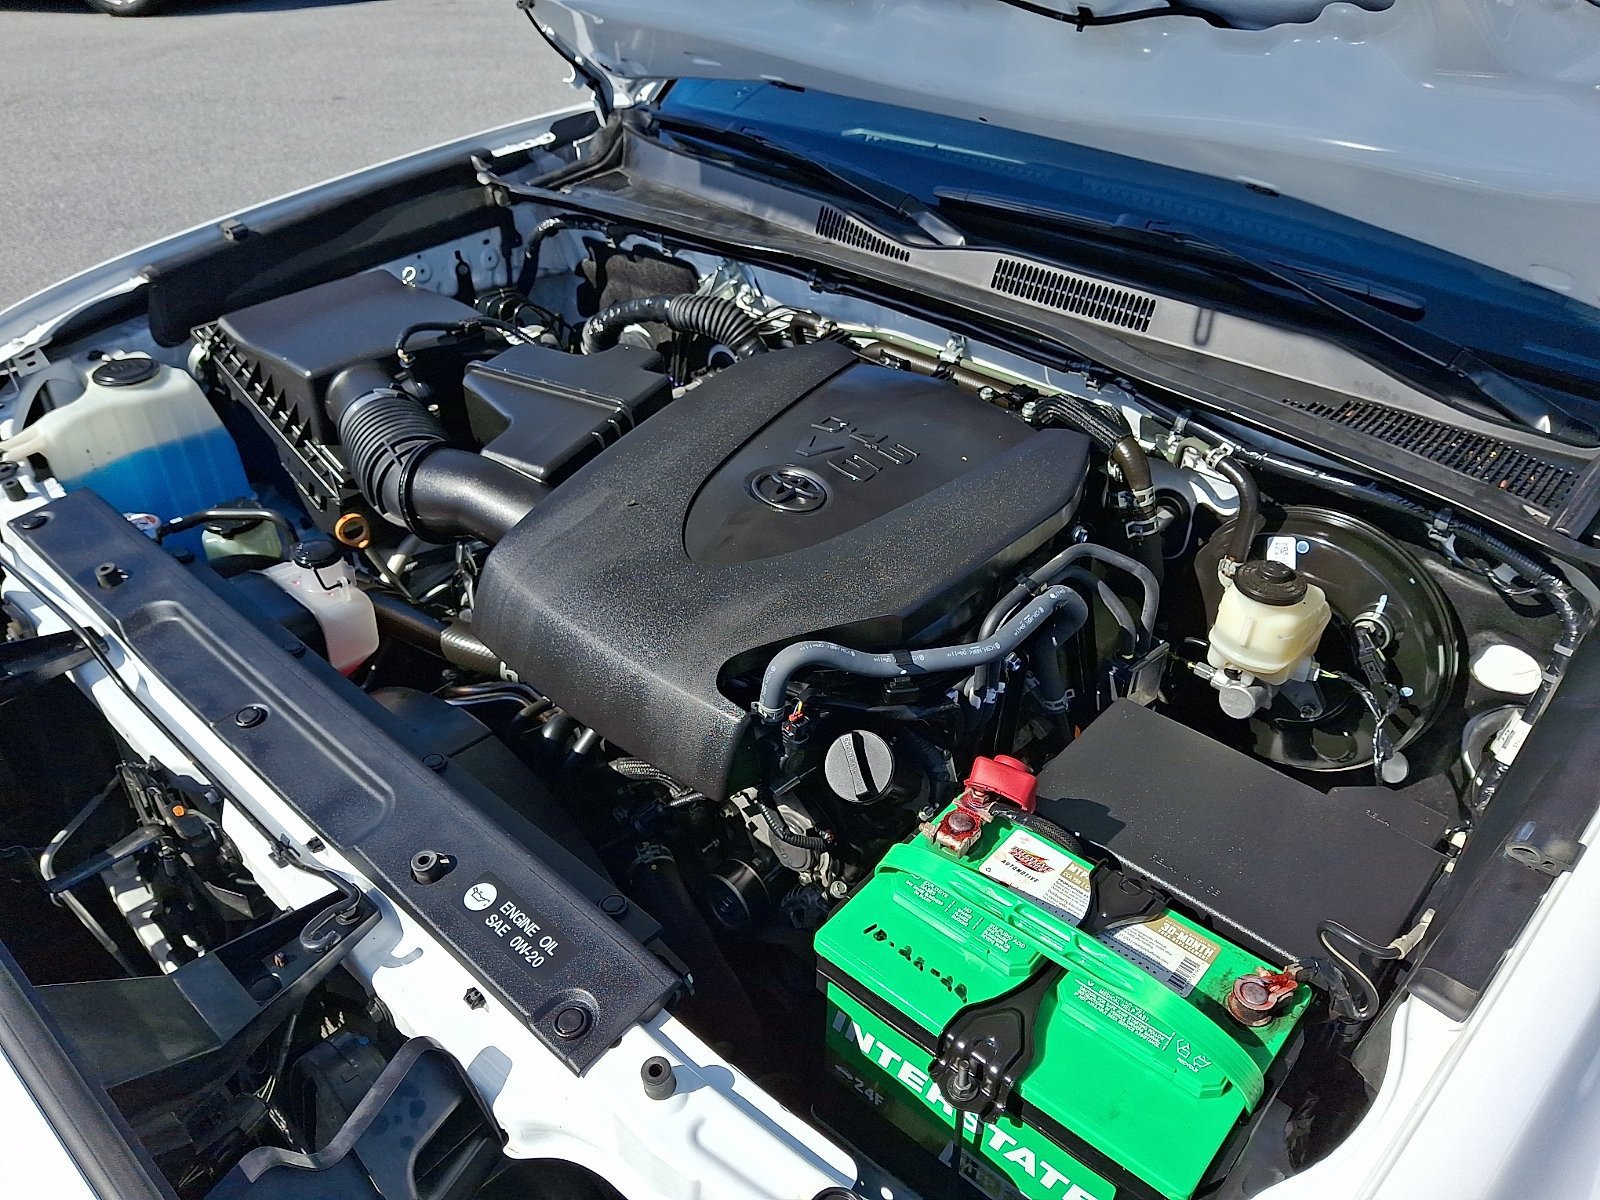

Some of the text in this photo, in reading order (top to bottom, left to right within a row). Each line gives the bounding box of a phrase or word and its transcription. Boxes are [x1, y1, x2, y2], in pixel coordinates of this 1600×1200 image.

[1000, 859, 1039, 883] AUTOMOTIVE
[484, 914, 544, 968] SAE 0W-20
[500, 900, 561, 956] ENGINE OIL
[1160, 922, 1214, 957] 30-MONTH
[853, 1079, 884, 1106] 24F
